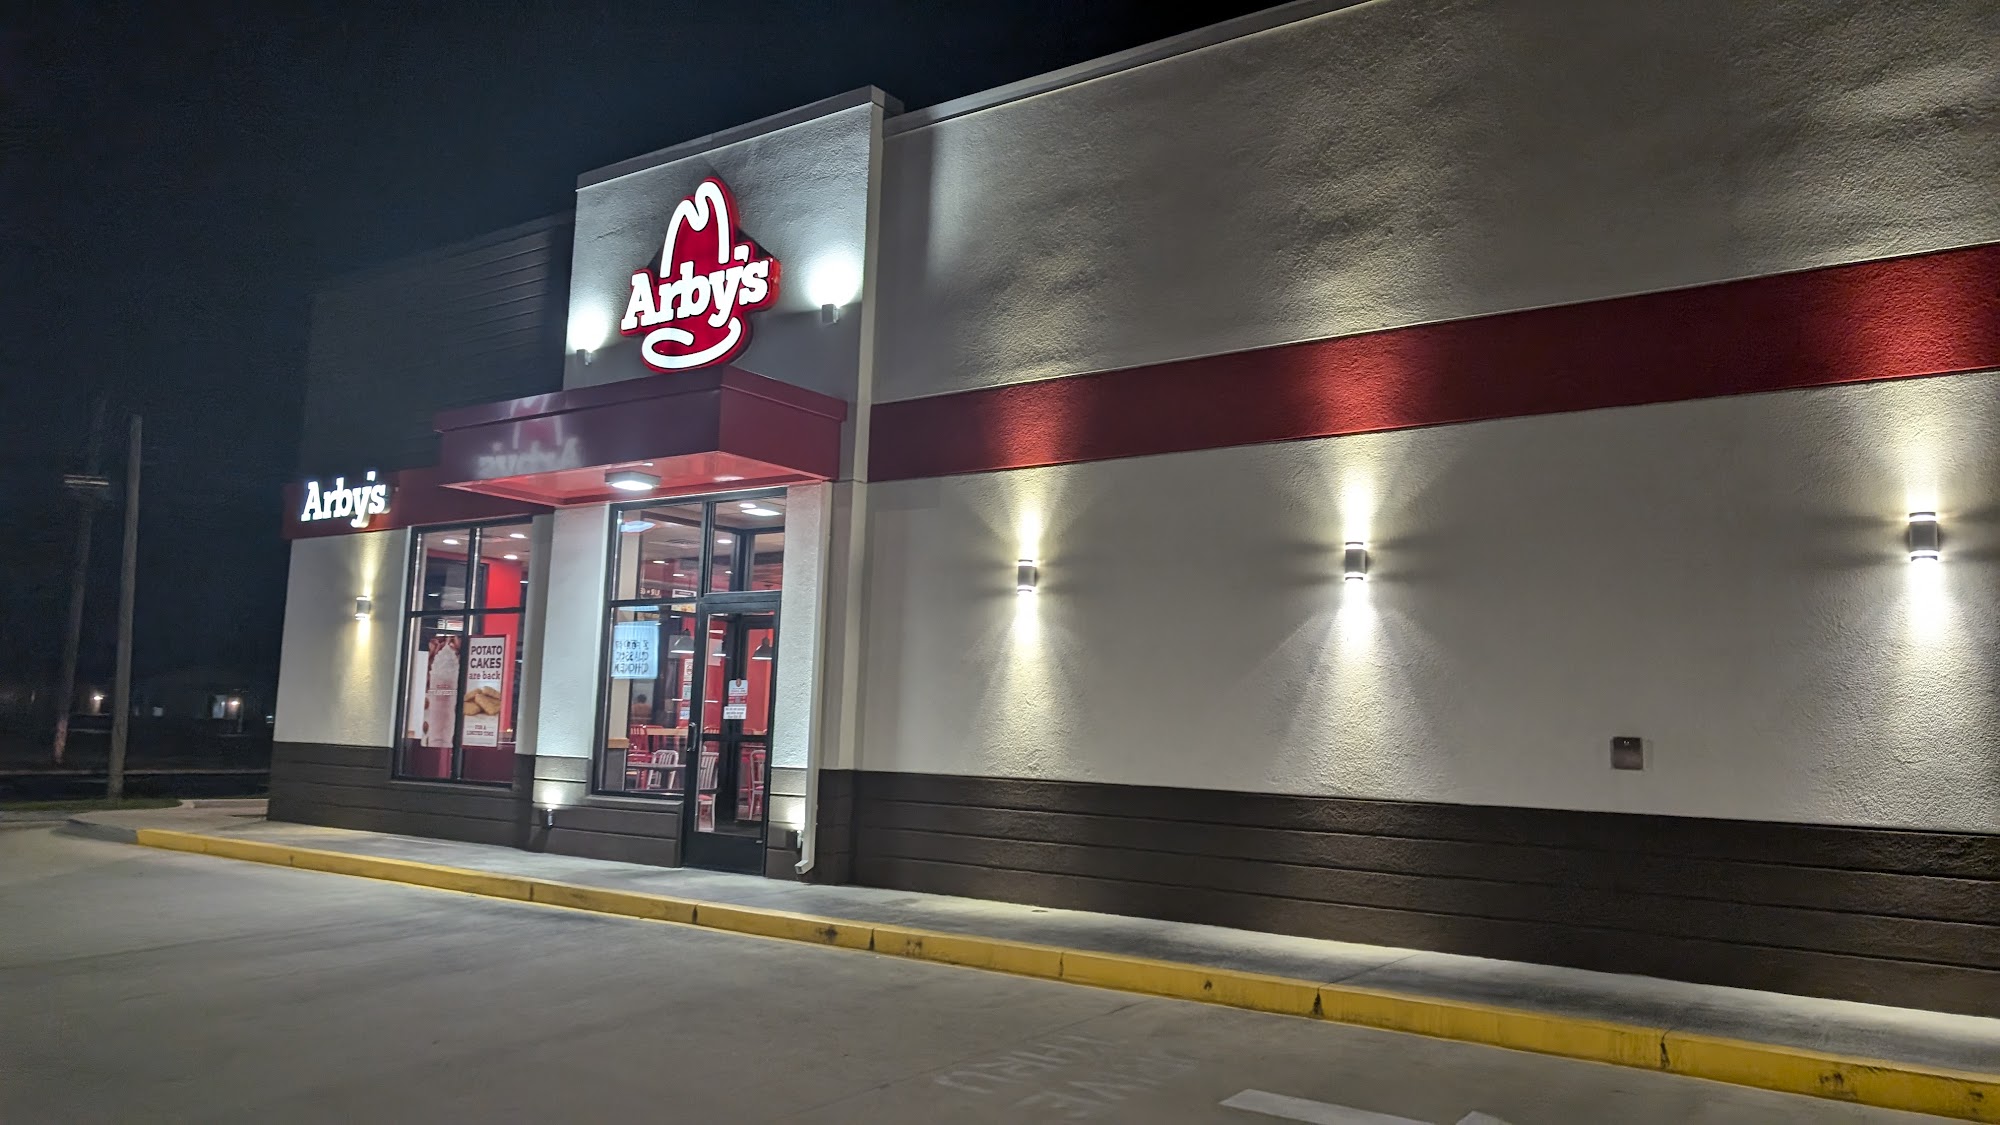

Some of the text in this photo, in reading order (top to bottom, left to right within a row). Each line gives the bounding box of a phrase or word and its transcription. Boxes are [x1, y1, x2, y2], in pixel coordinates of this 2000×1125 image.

[620, 244, 770, 331] Arby's
[300, 470, 388, 529] Arby's
[471, 645, 503, 655] POTATO
[470, 657, 502, 669] CAKES
[482, 671, 501, 680] back
